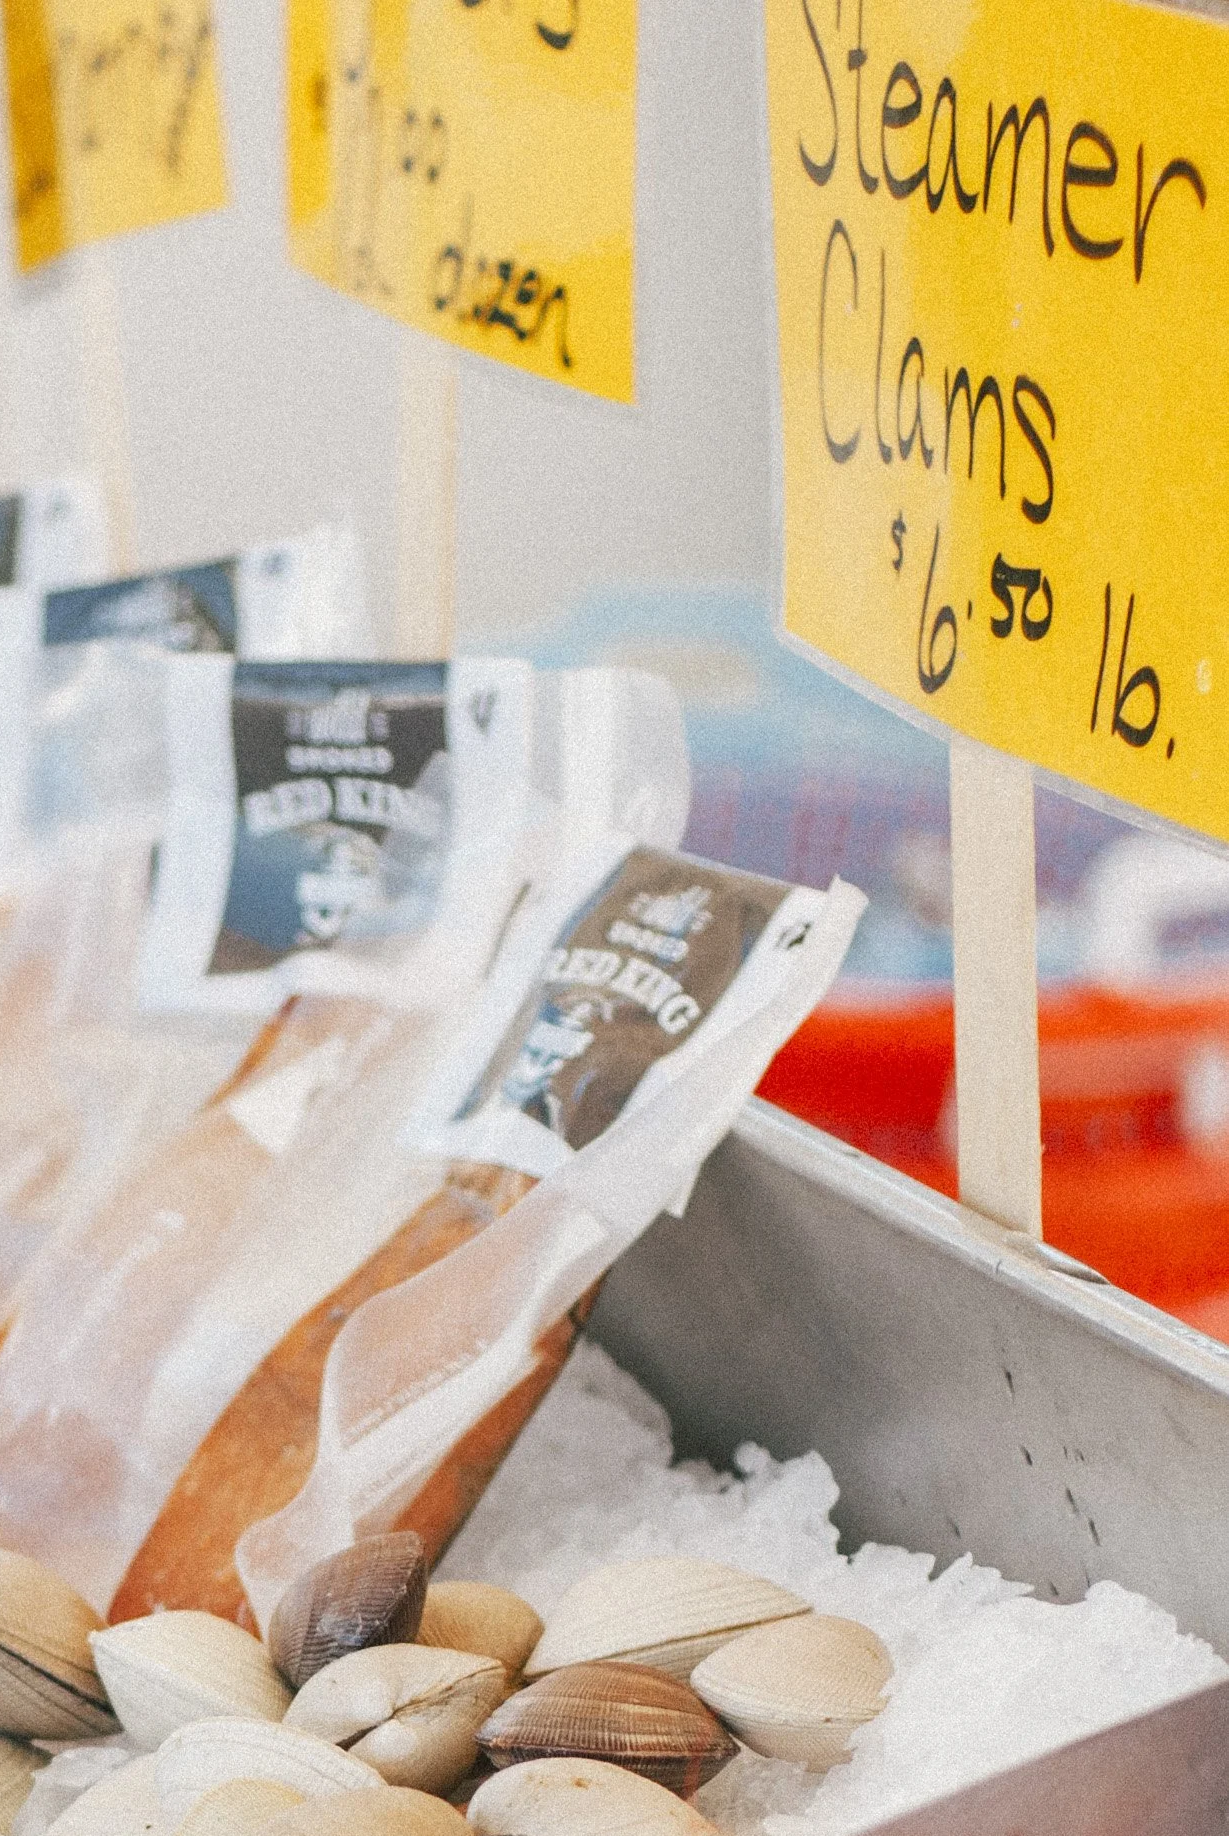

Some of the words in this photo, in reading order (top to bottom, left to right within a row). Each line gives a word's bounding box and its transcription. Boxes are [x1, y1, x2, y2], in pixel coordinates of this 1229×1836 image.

[798, 0, 1205, 283] Steamer
[818, 218, 1056, 525] Clams
[1090, 581, 1175, 760] lb.
[612, 956, 701, 1035] KING
